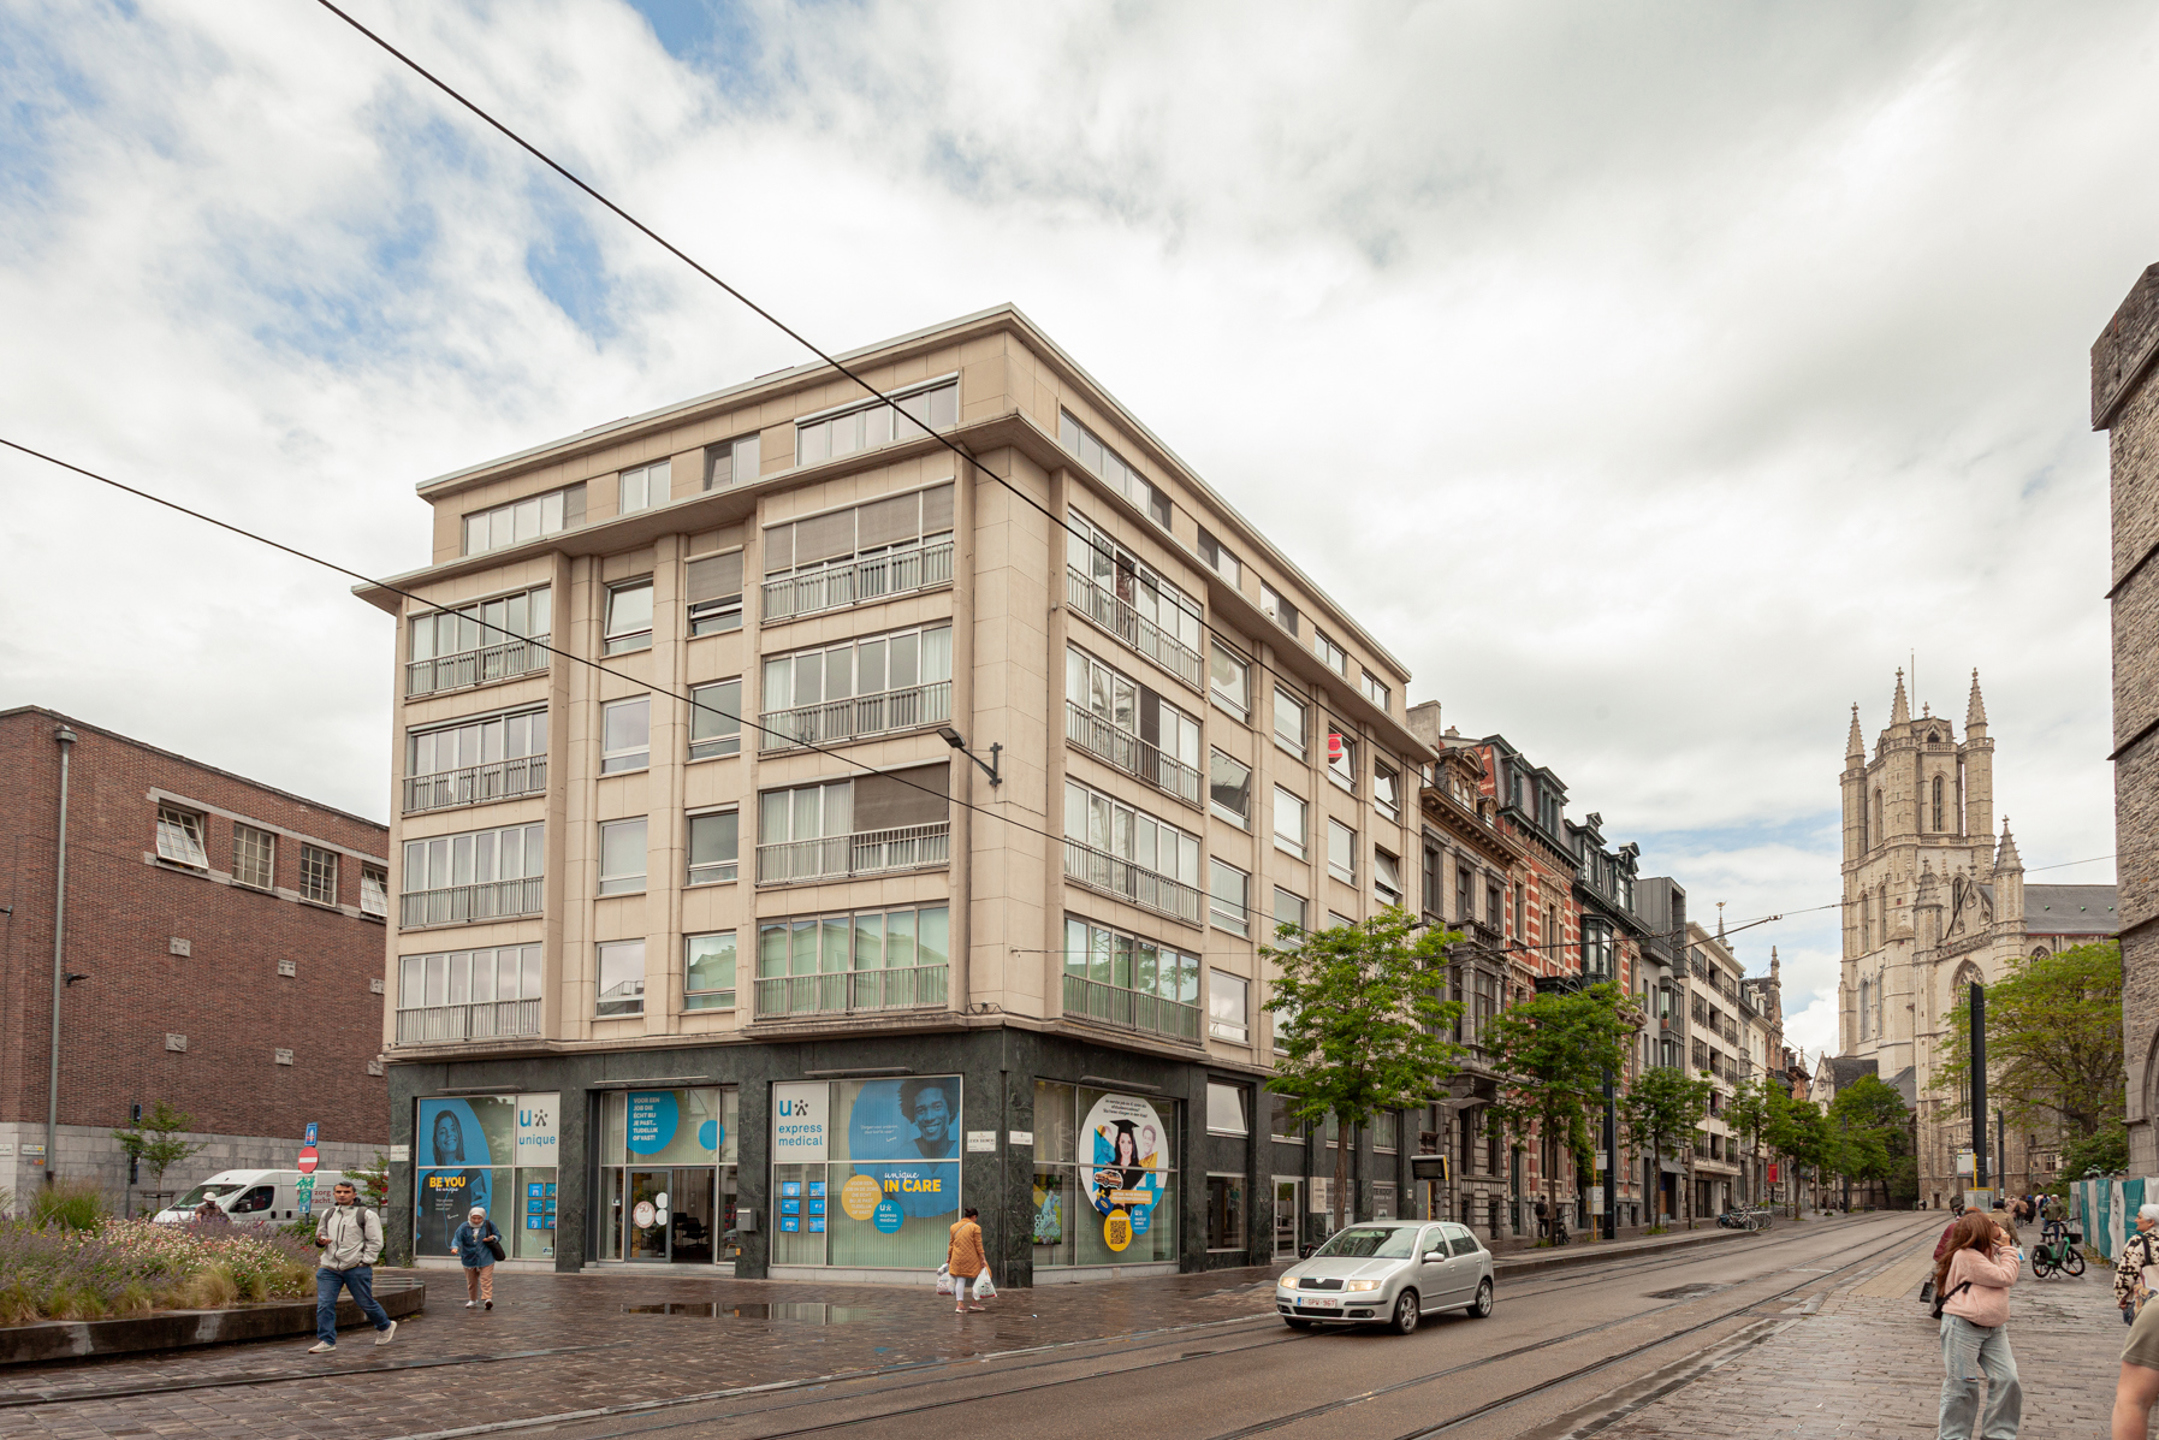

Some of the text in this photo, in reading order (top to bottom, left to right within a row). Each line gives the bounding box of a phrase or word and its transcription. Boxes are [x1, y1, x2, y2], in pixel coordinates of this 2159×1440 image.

[778, 1124, 822, 1135] express
[519, 1134, 556, 1147] unique
[778, 1135, 822, 1146] medical
[429, 1176, 466, 1188] BE YOU
[884, 1170, 920, 1183] unique
[884, 1179, 942, 1192] IN CARE
